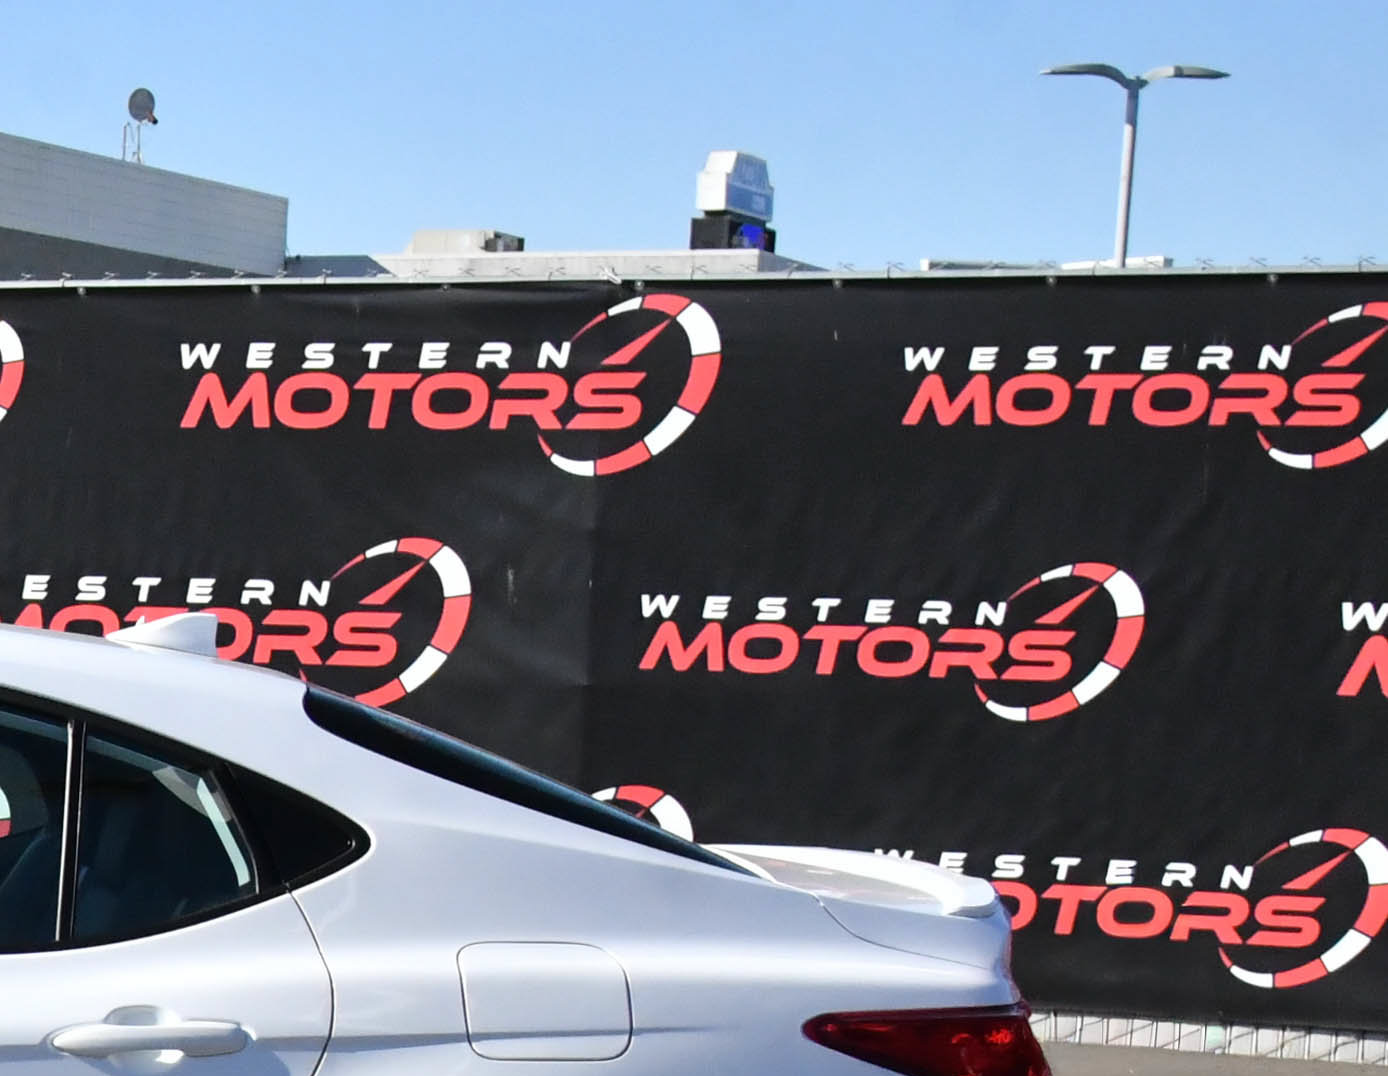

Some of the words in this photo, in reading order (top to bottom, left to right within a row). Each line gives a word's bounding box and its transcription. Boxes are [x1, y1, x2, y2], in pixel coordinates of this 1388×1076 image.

[180, 342, 571, 369] WESTERN
[904, 345, 1292, 371] WESTERN
[180, 371, 646, 430] MOTORS
[902, 373, 1365, 426] MOTORS
[640, 594, 1006, 626] WESTERN
[639, 620, 1076, 682] MOTORS
[991, 881, 1326, 948] OTORS
